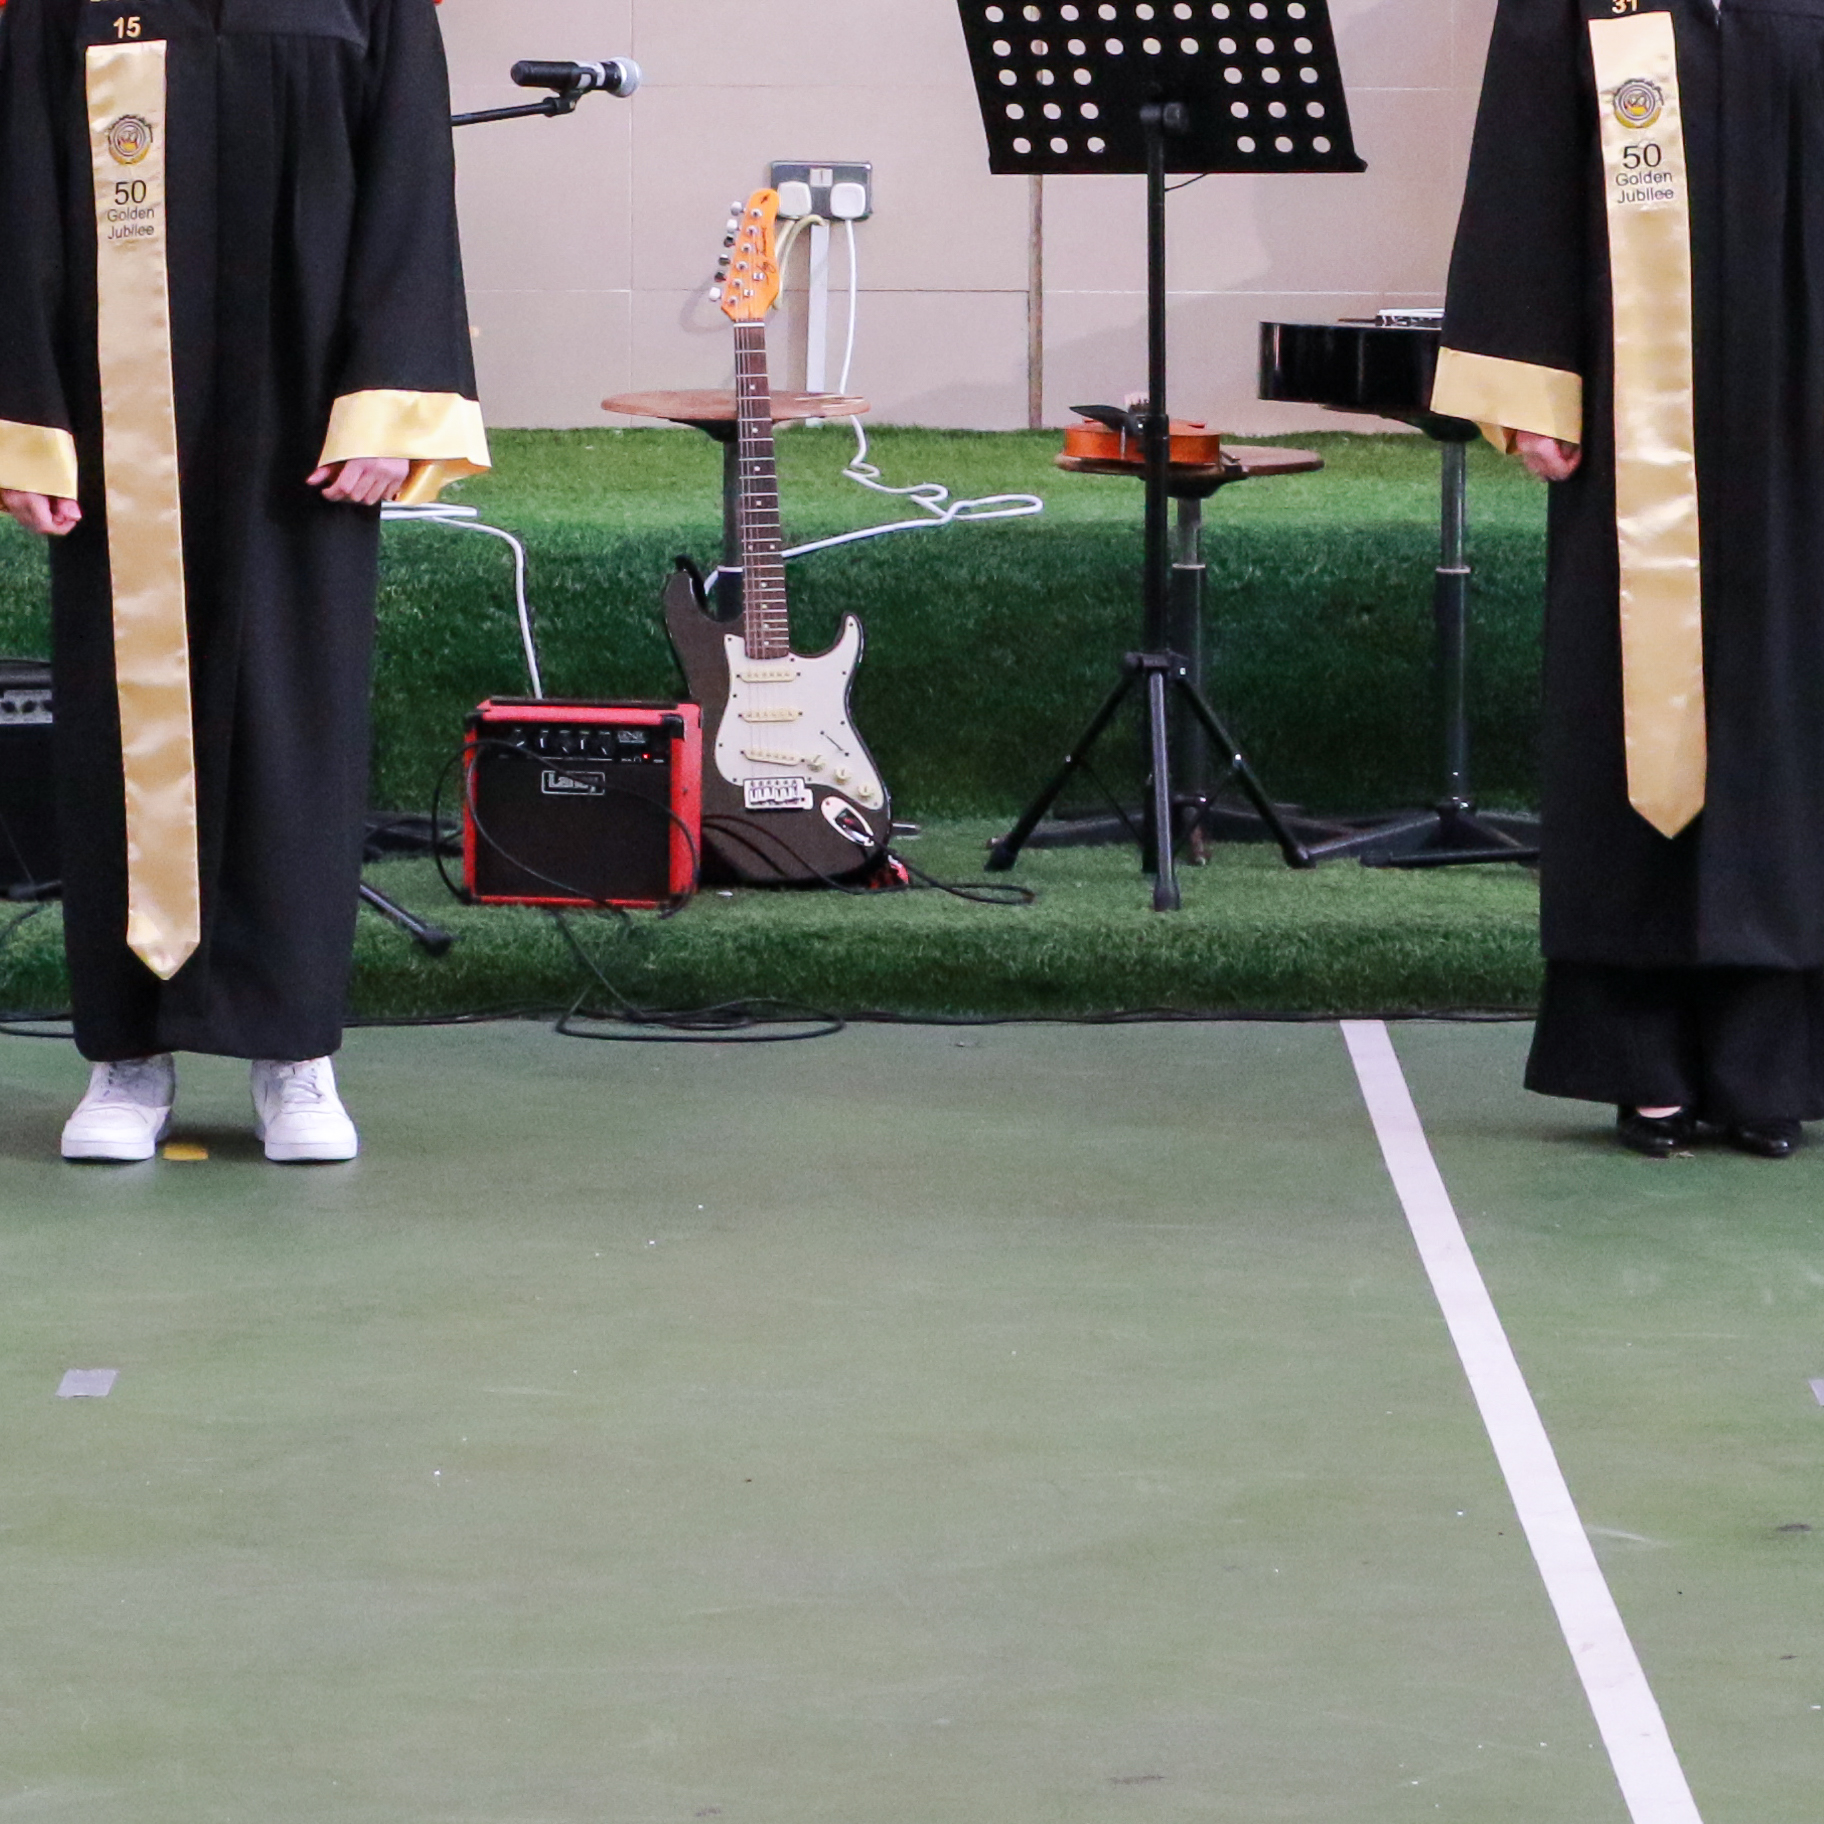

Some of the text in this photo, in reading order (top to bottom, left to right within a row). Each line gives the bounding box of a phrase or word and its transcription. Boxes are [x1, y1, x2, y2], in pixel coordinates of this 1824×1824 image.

[113, 16, 142, 39] 15
[1622, 143, 1662, 169] 50
[1615, 170, 1673, 187] Golden
[114, 179, 147, 206] 50
[1616, 187, 1674, 204] Jubilee
[106, 206, 155, 224] Golden
[107, 224, 155, 240] Jubilee
